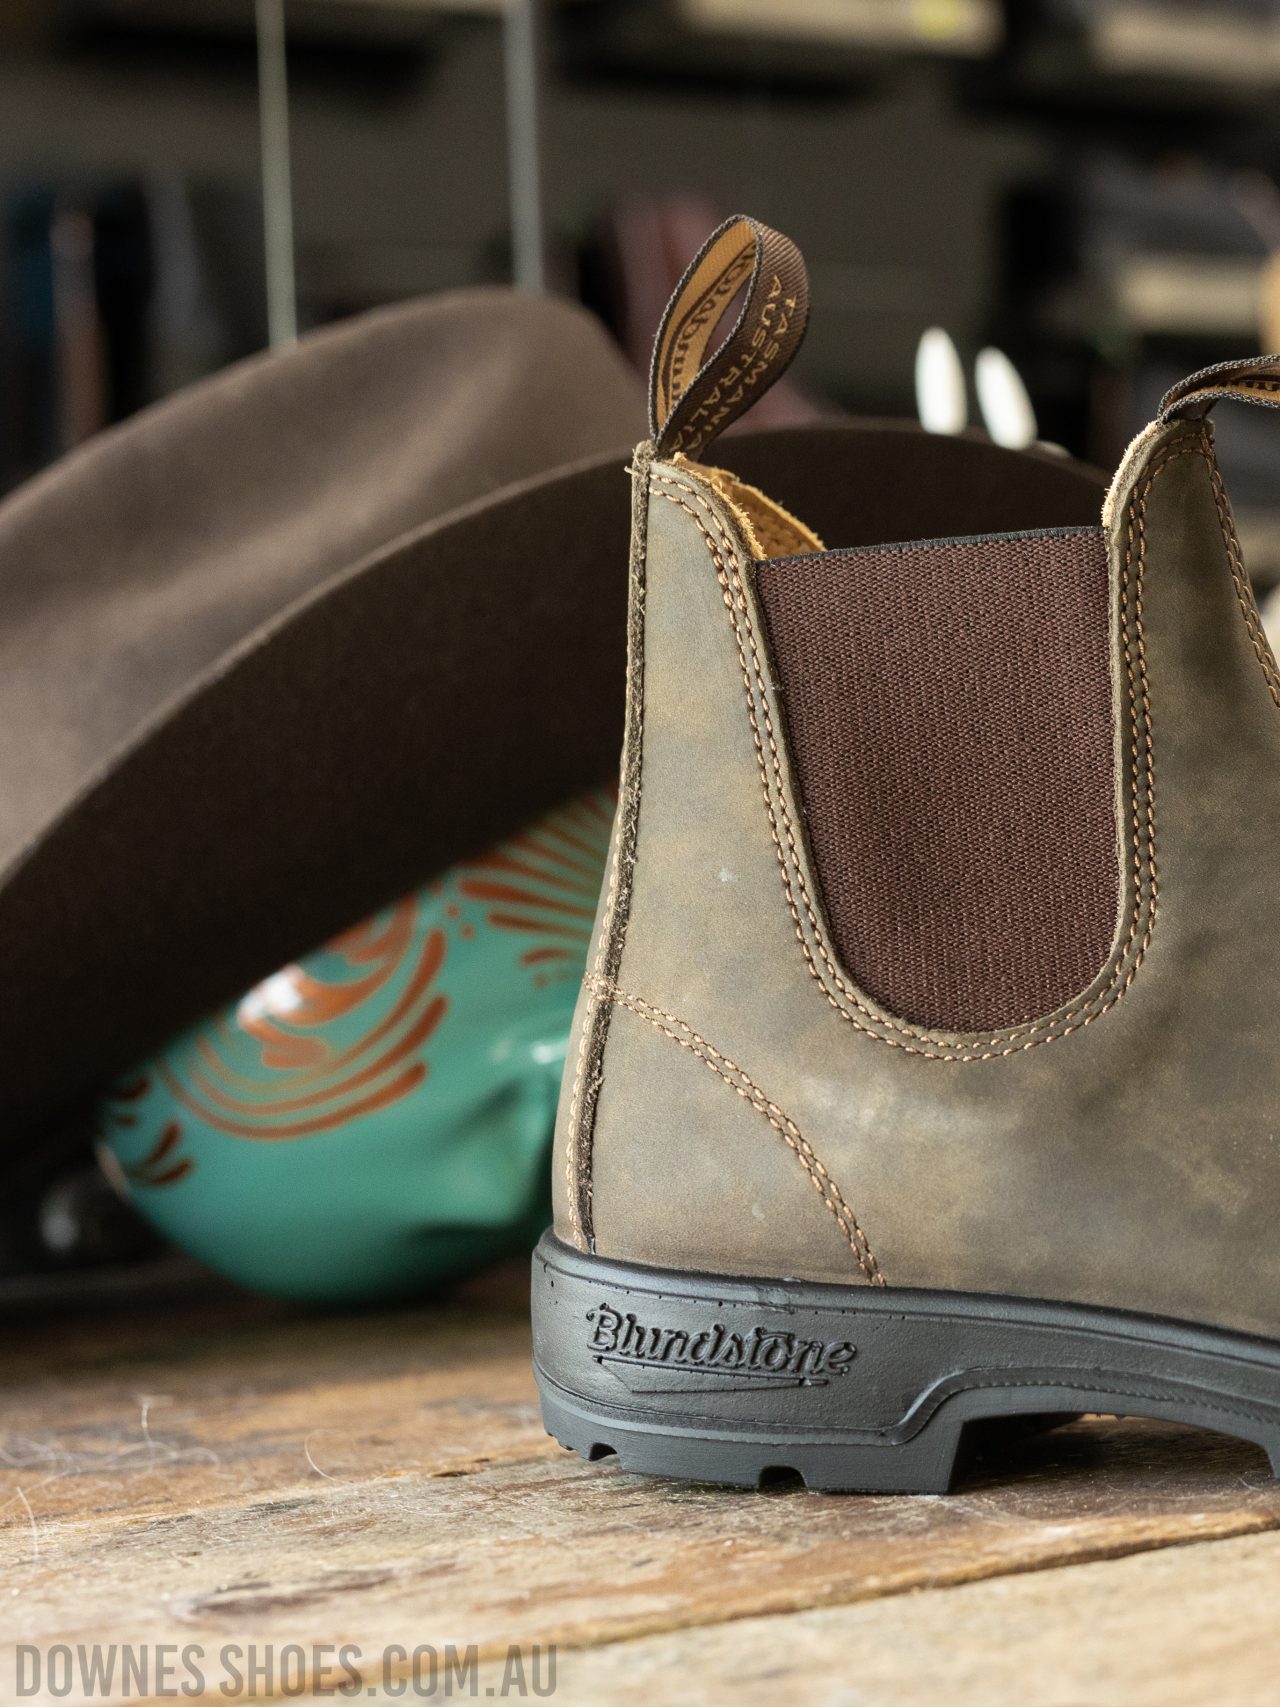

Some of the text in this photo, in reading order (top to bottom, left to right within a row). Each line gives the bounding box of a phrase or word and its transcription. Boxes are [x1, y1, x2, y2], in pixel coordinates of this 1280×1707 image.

[671, 274, 783, 451] AUSTRALIA
[687, 295, 797, 450] TASMANIA
[586, 1302, 858, 1376] Blundstone
